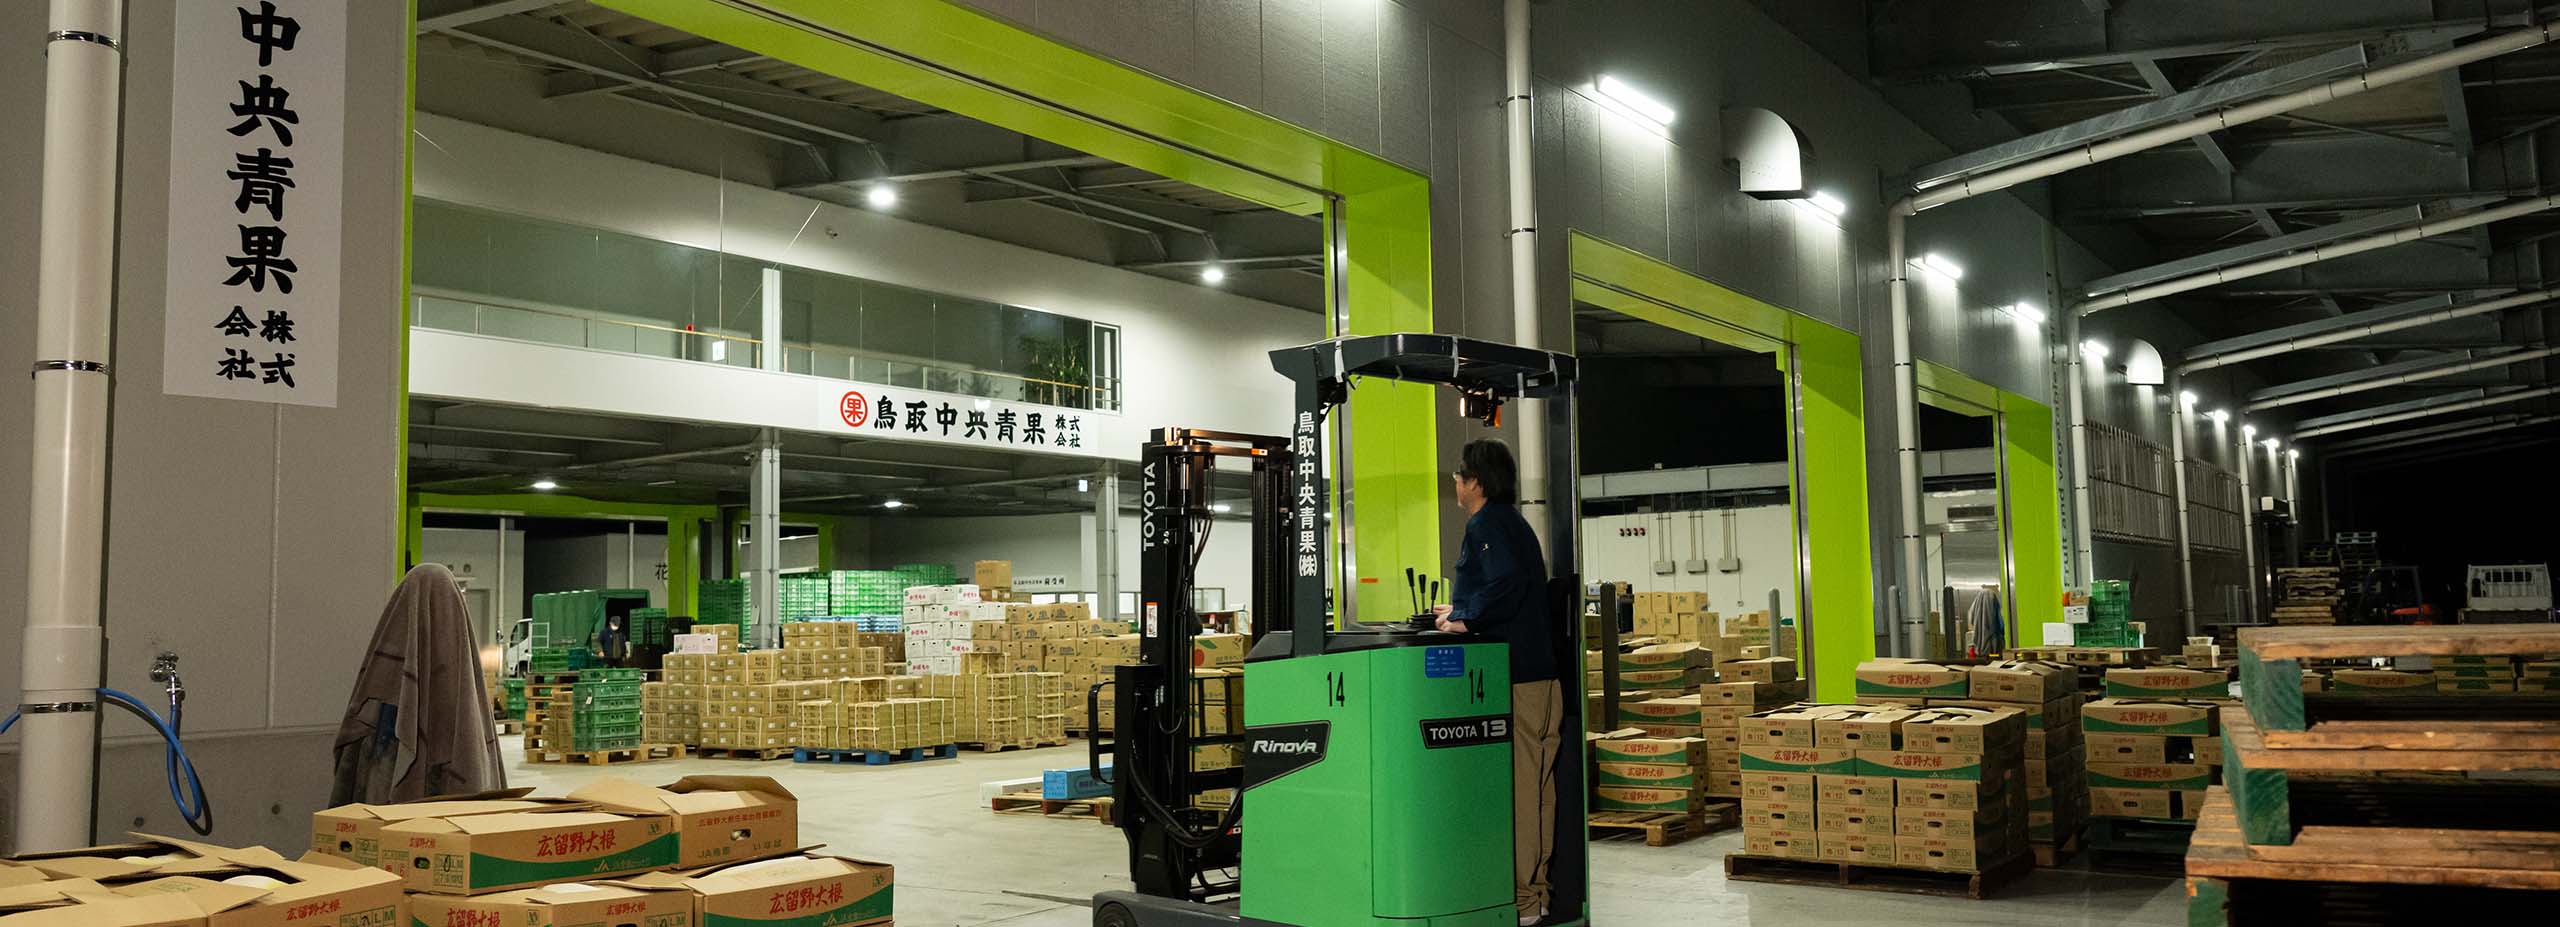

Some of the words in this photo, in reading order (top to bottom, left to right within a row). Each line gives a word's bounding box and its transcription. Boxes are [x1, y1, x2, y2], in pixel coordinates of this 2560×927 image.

[222, 0, 301, 294] 中央青果
[873, 394, 1047, 446] 鳥取中央青果
[1143, 462, 1156, 552] TOYOTA
[1327, 671, 1345, 707] 14
[1469, 667, 1485, 704] 14
[1429, 725, 1478, 741] TOYOTA
[1482, 719, 1507, 738] 13
[537, 830, 617, 857] 広留野大根
[770, 882, 844, 915] 広留野大根
